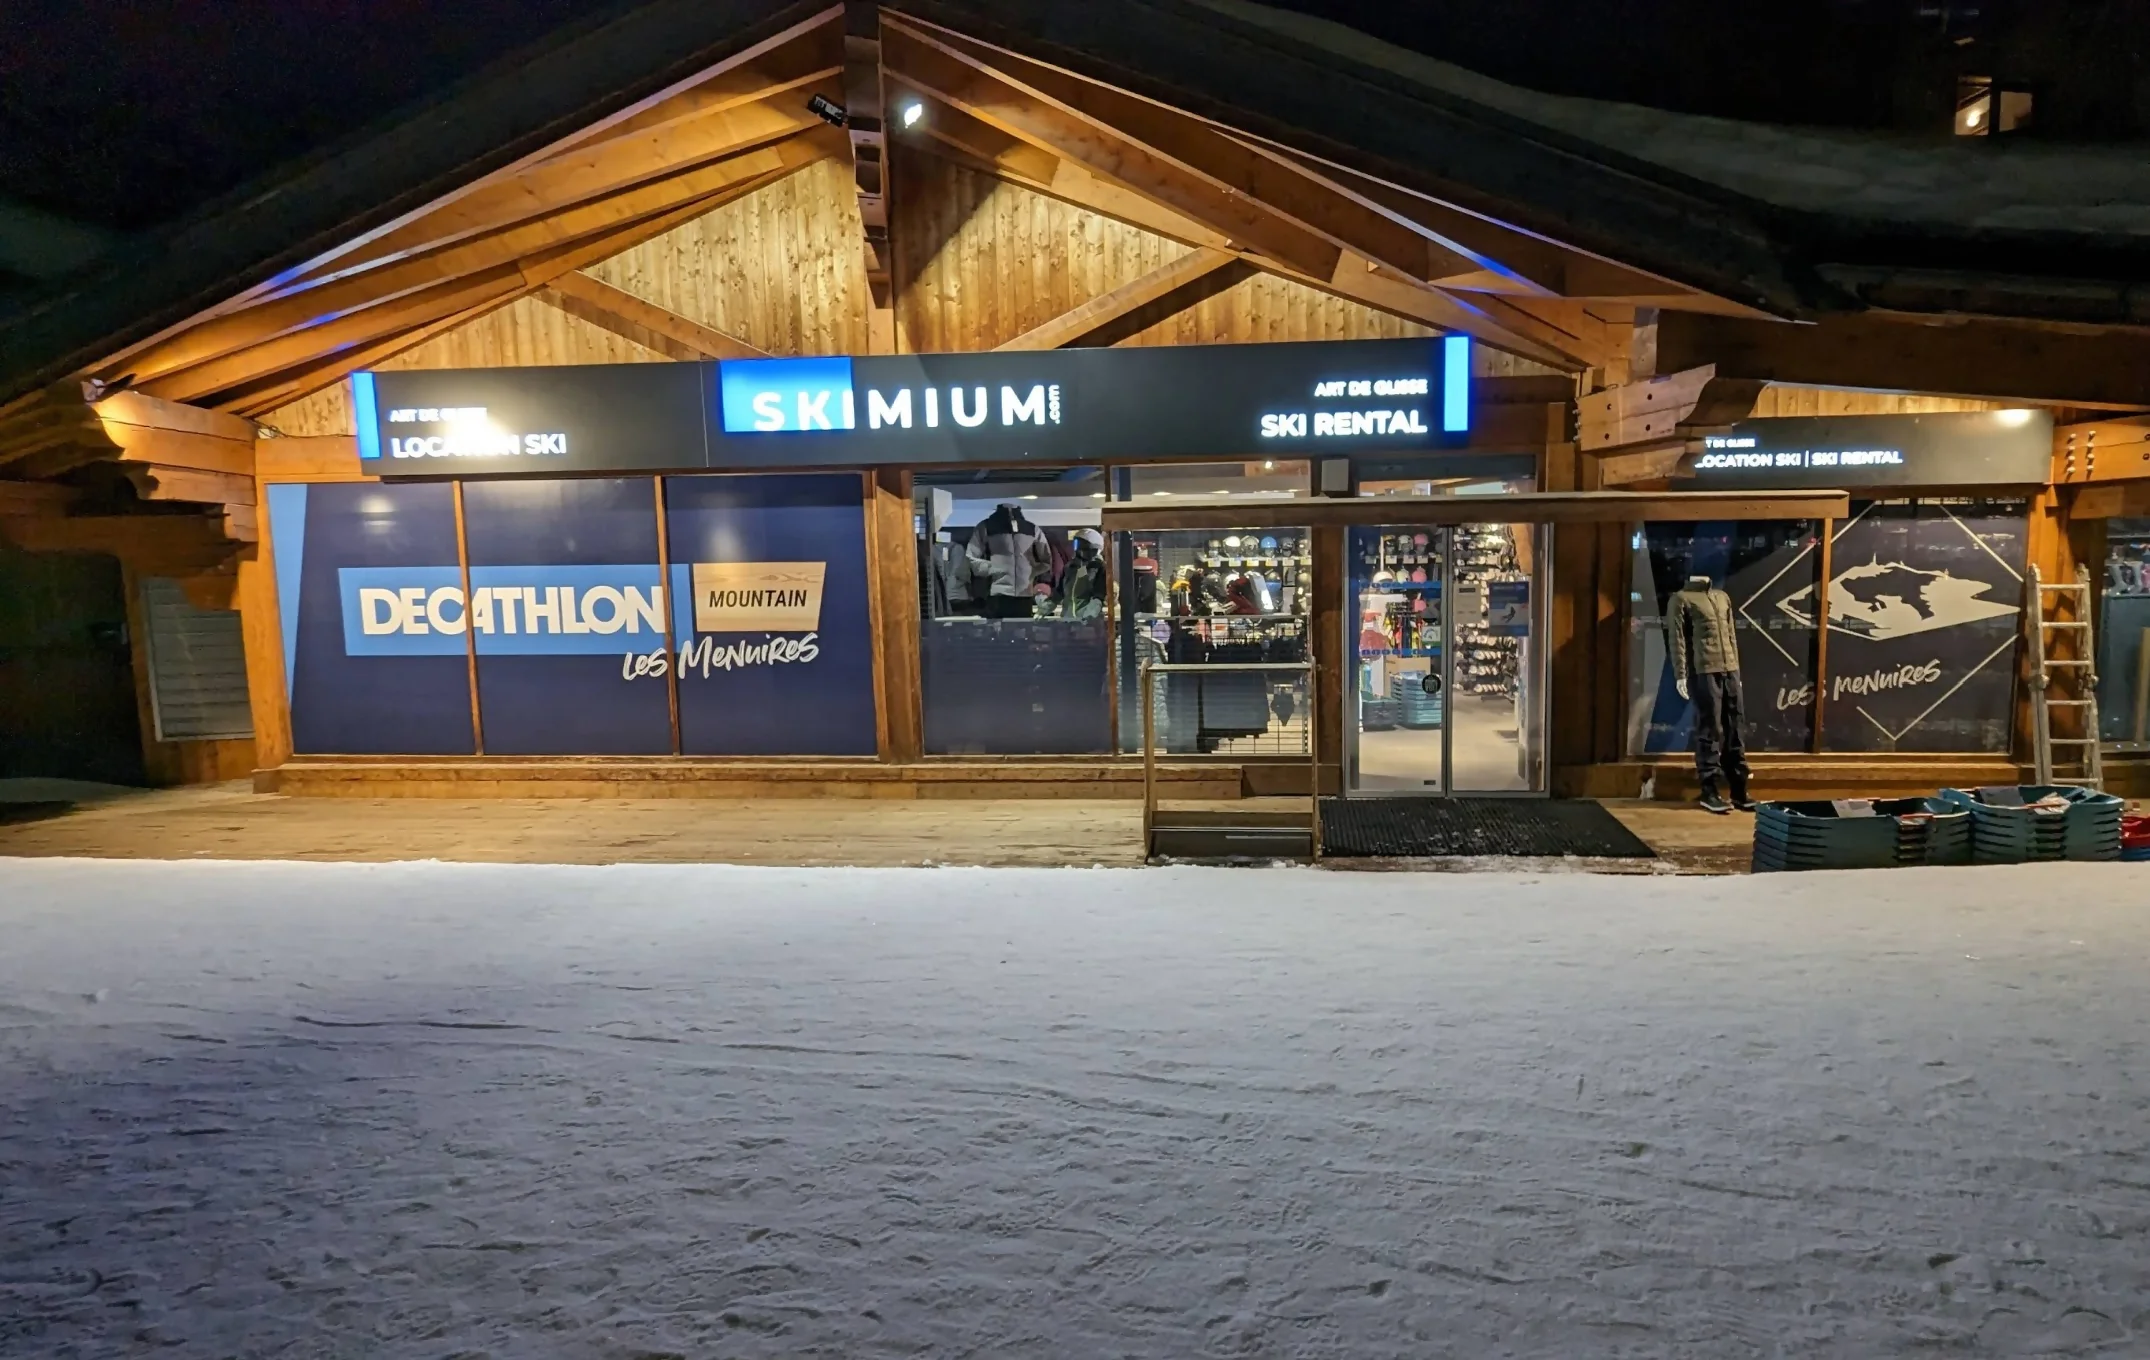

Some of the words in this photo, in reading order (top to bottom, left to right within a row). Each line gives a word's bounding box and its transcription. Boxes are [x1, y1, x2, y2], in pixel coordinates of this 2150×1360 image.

[1314, 381, 1347, 397] ART
[1348, 380, 1372, 396] DE
[752, 384, 1046, 431] SKIMIUM
[1260, 413, 1308, 438] SKI
[1313, 409, 1429, 437] RENTAL
[524, 433, 567, 456] SKI
[1775, 452, 1801, 467] SKI
[1811, 451, 1837, 466] SKI
[1840, 450, 1904, 465] RENTAL
[359, 585, 667, 635] DECATHLON
[709, 589, 808, 608] MOUNTAIN
